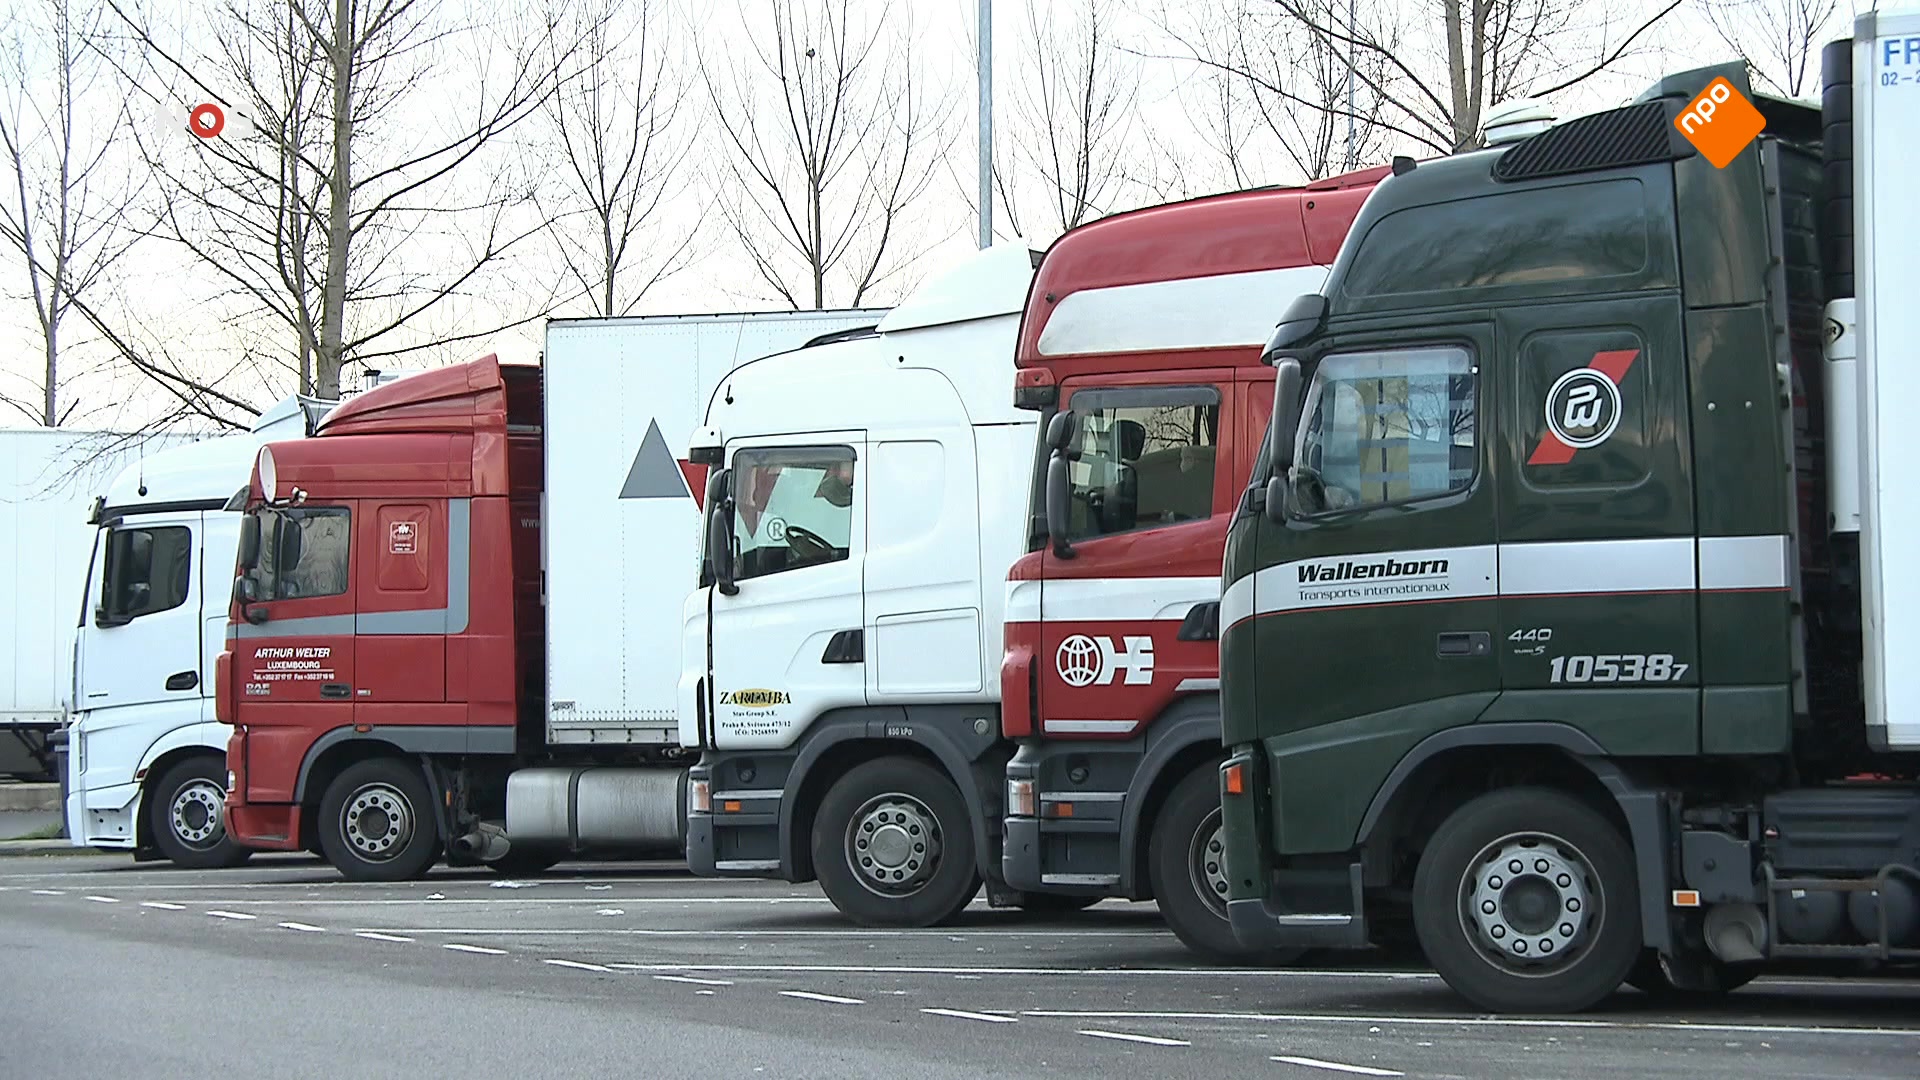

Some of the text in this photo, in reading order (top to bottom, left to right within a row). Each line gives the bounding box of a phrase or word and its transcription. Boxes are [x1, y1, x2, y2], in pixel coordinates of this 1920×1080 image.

[1298, 559, 1449, 584] Wallenborn
[1298, 582, 1450, 600] Transports internationaux
[1508, 628, 1553, 642] 440
[254, 647, 331, 659] ARTHUR WELTER
[266, 661, 320, 670] LUXEMBOURG
[719, 691, 792, 704] ZAREMBA
